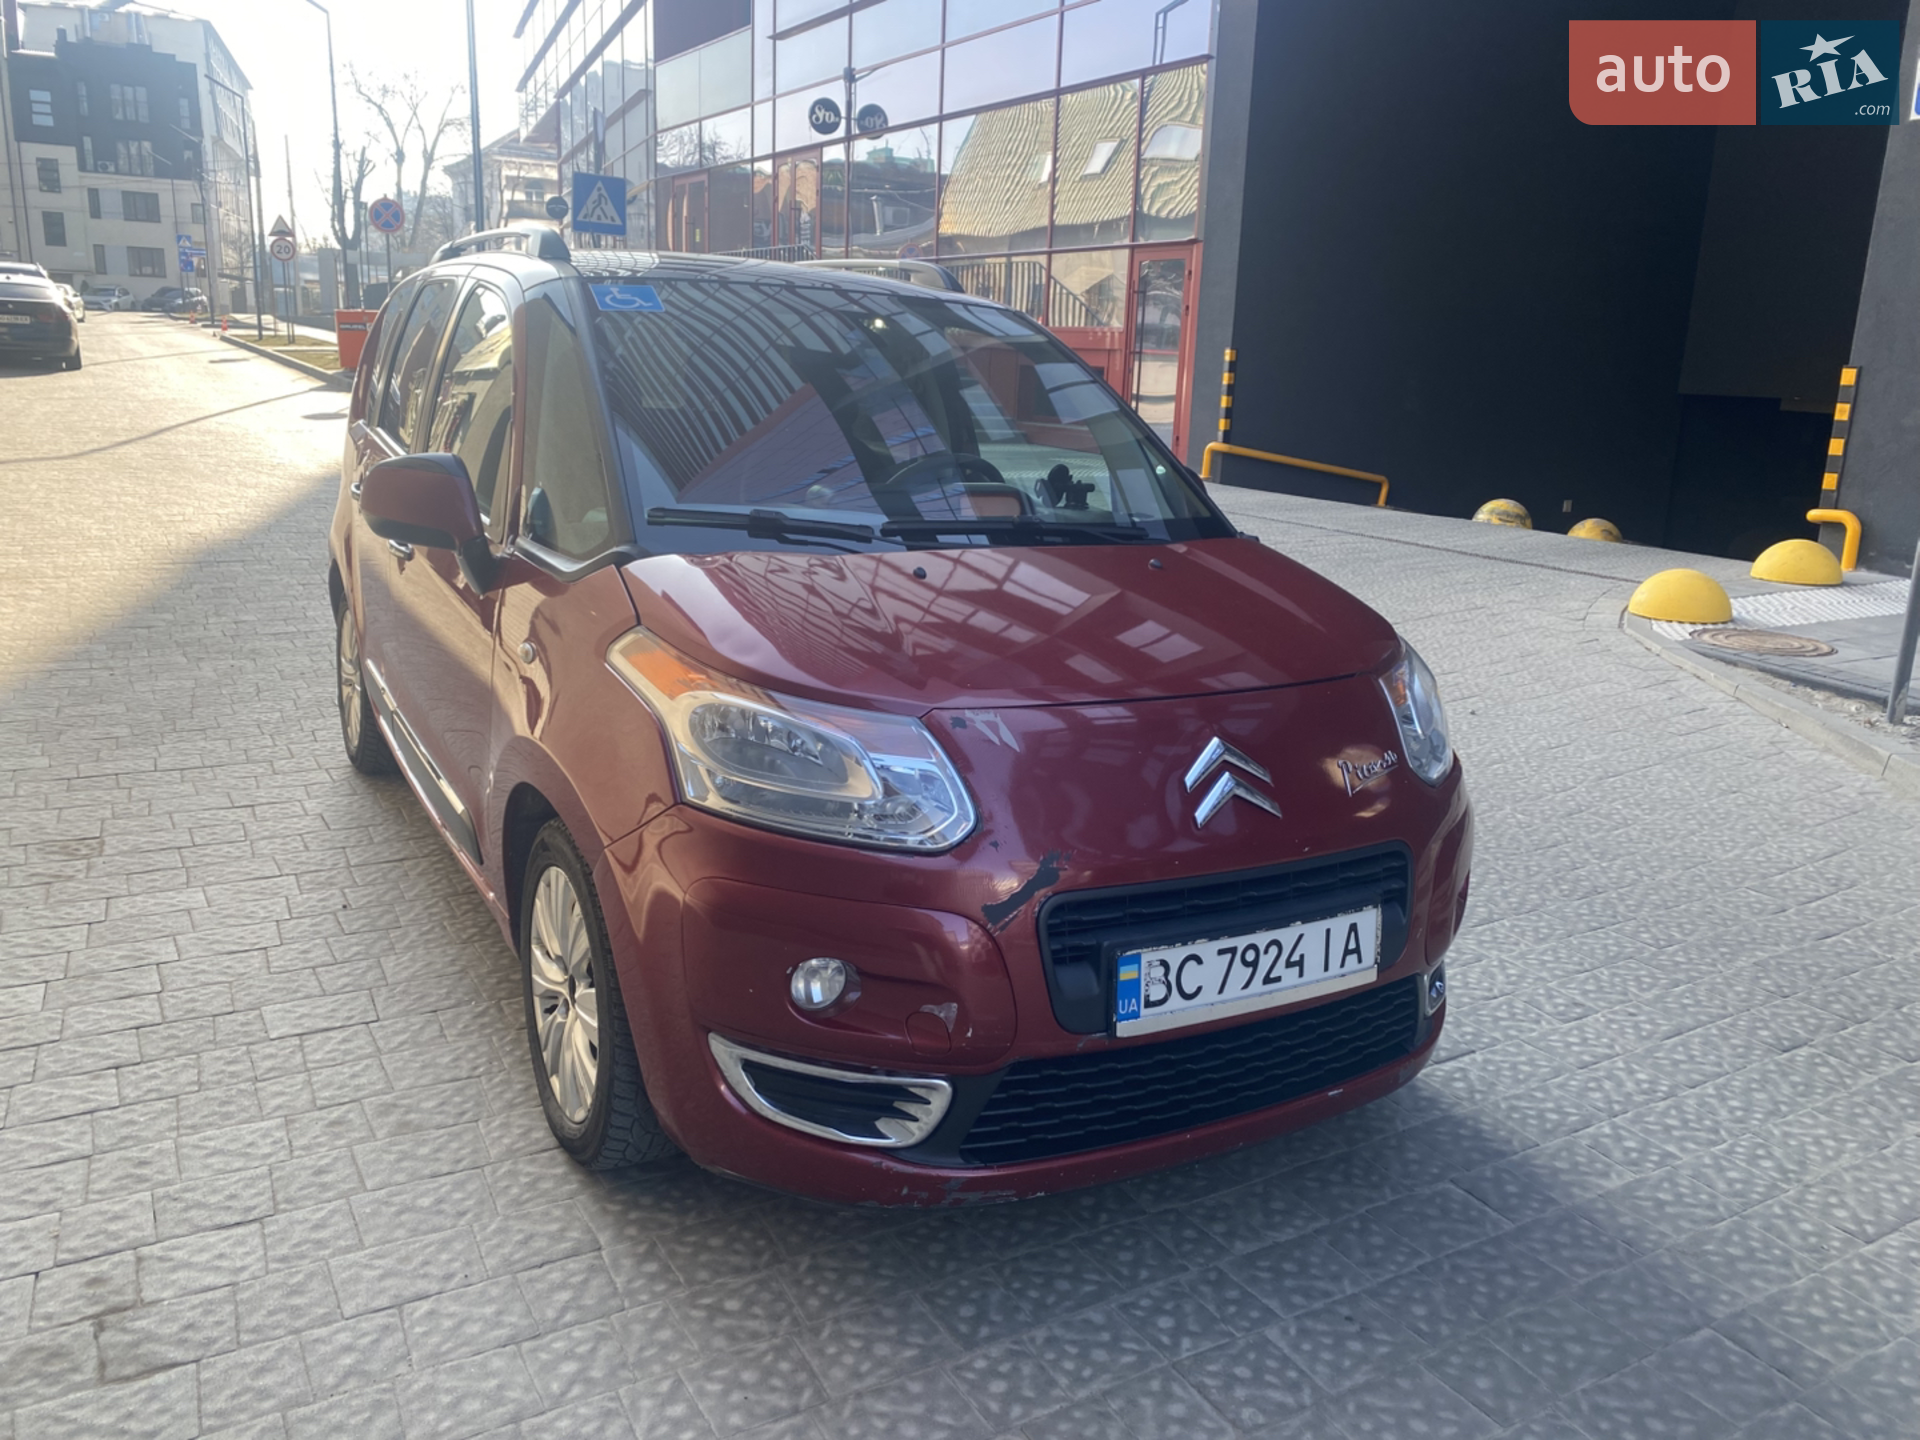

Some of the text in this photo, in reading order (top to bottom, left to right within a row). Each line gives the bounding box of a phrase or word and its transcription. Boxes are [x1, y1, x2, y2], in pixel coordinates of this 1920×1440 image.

[276, 244, 291, 255] 20
[1143, 921, 1363, 1009] BC 7924 IA
[1118, 999, 1138, 1014] UA
